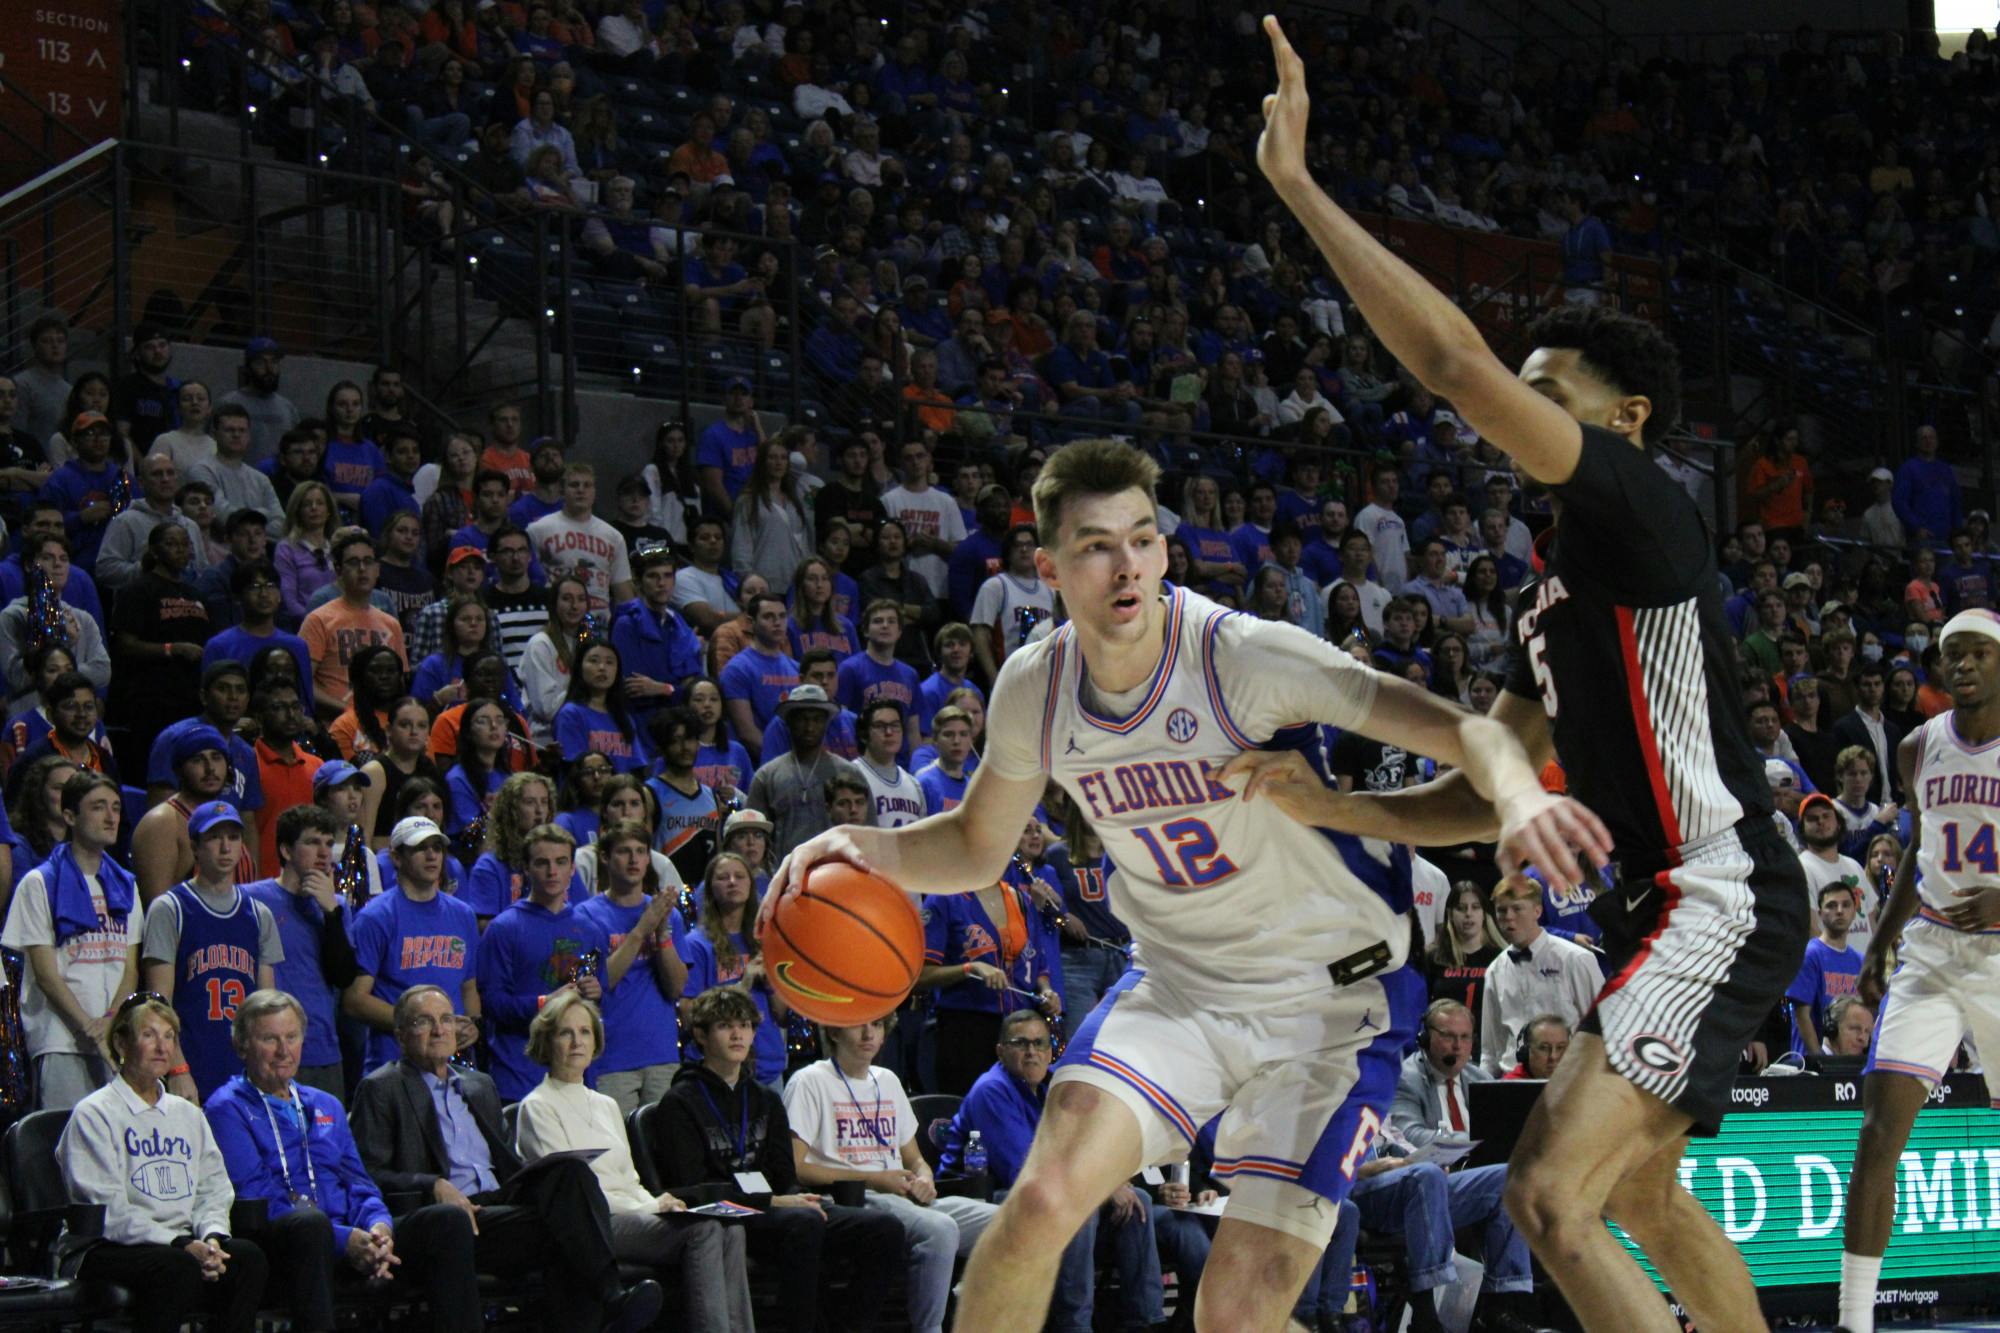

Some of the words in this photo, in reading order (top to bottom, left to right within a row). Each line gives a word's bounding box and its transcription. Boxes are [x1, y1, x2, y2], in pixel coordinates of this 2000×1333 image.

[36, 9, 109, 33] SECTION
[38, 38, 71, 63] 113
[48, 91, 71, 114] 13
[1169, 711, 1197, 740] SEC
[1076, 759, 1237, 819] FLORIDA
[1130, 817, 1240, 888] 12
[1942, 822, 1999, 874] 14
[1074, 867, 1104, 902] U
[207, 977, 246, 1021] 13
[155, 1167, 177, 1195] XL
[1899, 1289, 1939, 1304] Mortgage
